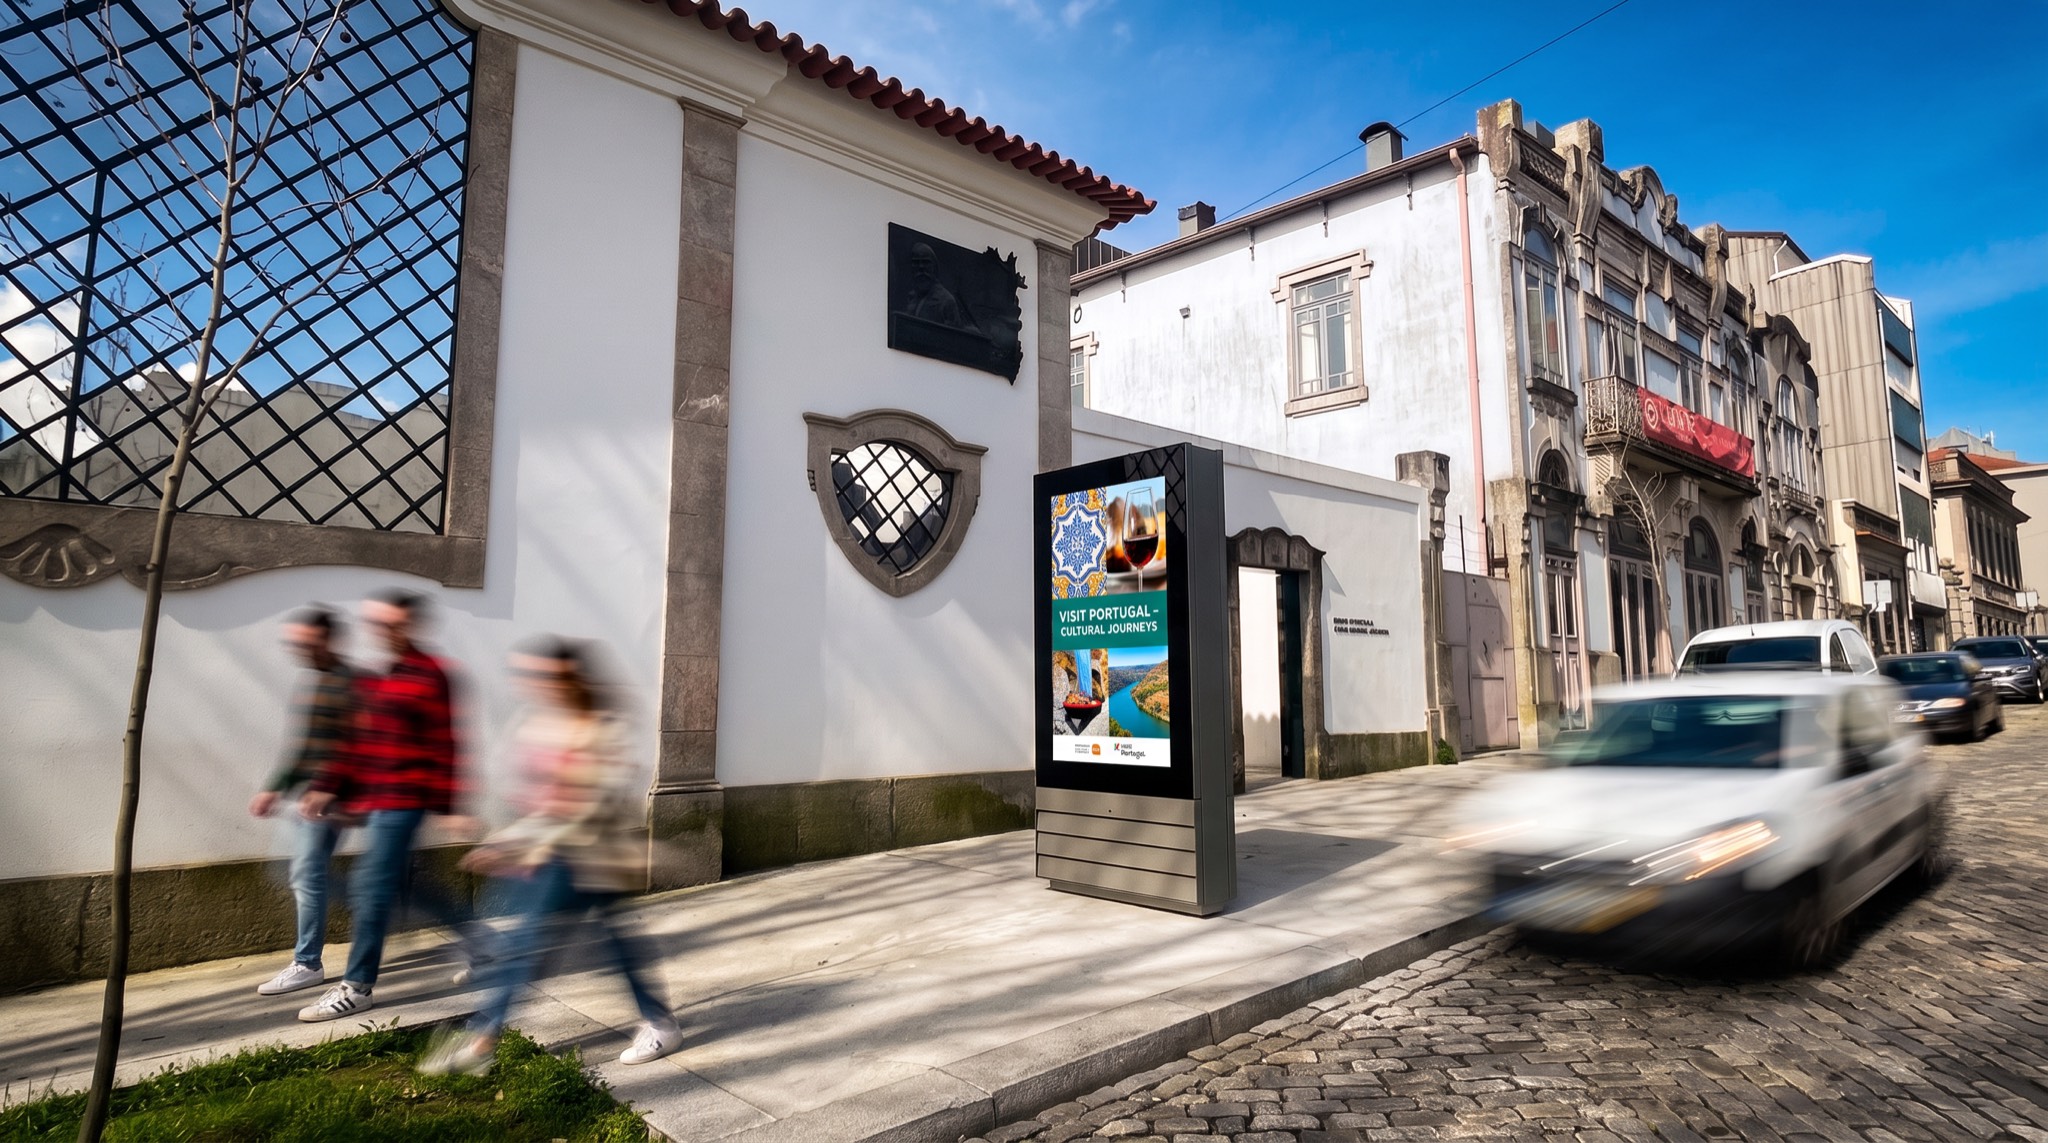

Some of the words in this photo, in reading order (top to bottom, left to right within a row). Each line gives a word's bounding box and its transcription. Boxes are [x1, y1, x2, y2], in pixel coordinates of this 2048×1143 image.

[1059, 610, 1086, 623] VISIT
[1090, 605, 1150, 621] PORTUGAL
[1060, 625, 1105, 637] CULTURAL
[1108, 621, 1158, 634] JOURNEYS
